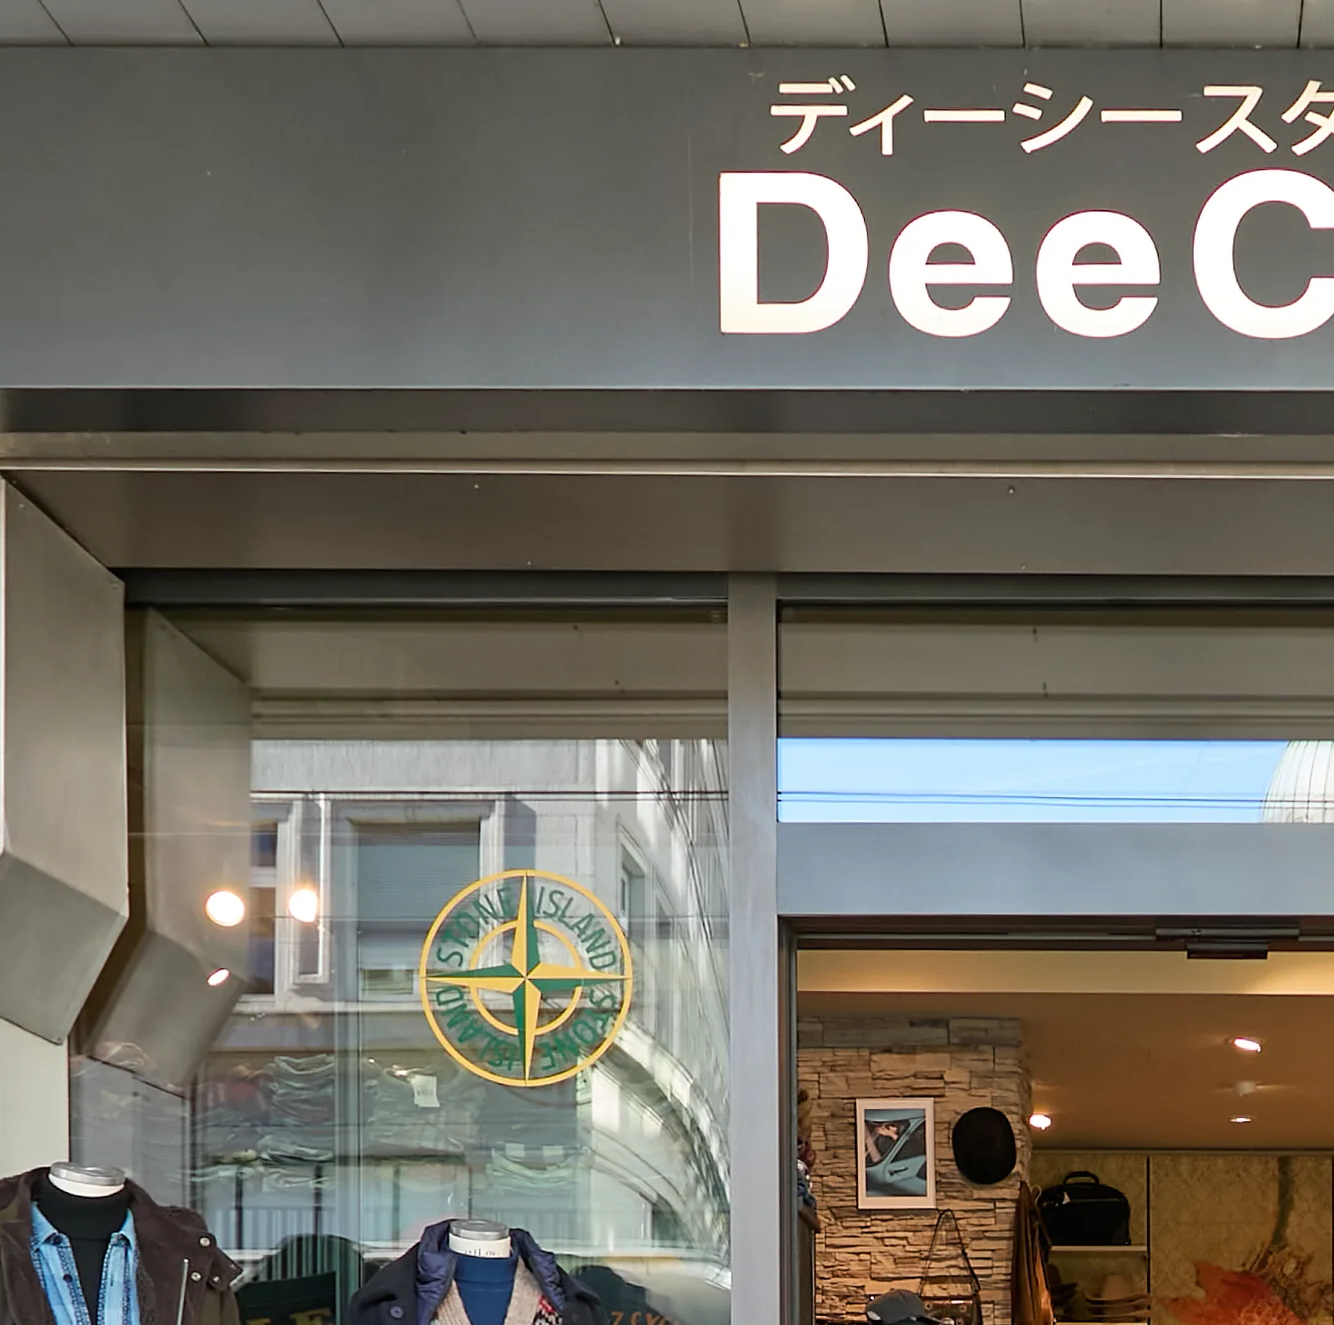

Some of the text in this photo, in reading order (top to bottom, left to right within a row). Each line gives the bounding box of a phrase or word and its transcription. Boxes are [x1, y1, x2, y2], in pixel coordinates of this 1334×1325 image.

[436, 886, 617, 971] STONE ISLAND
[435, 985, 618, 1072] STONE ISLAND
